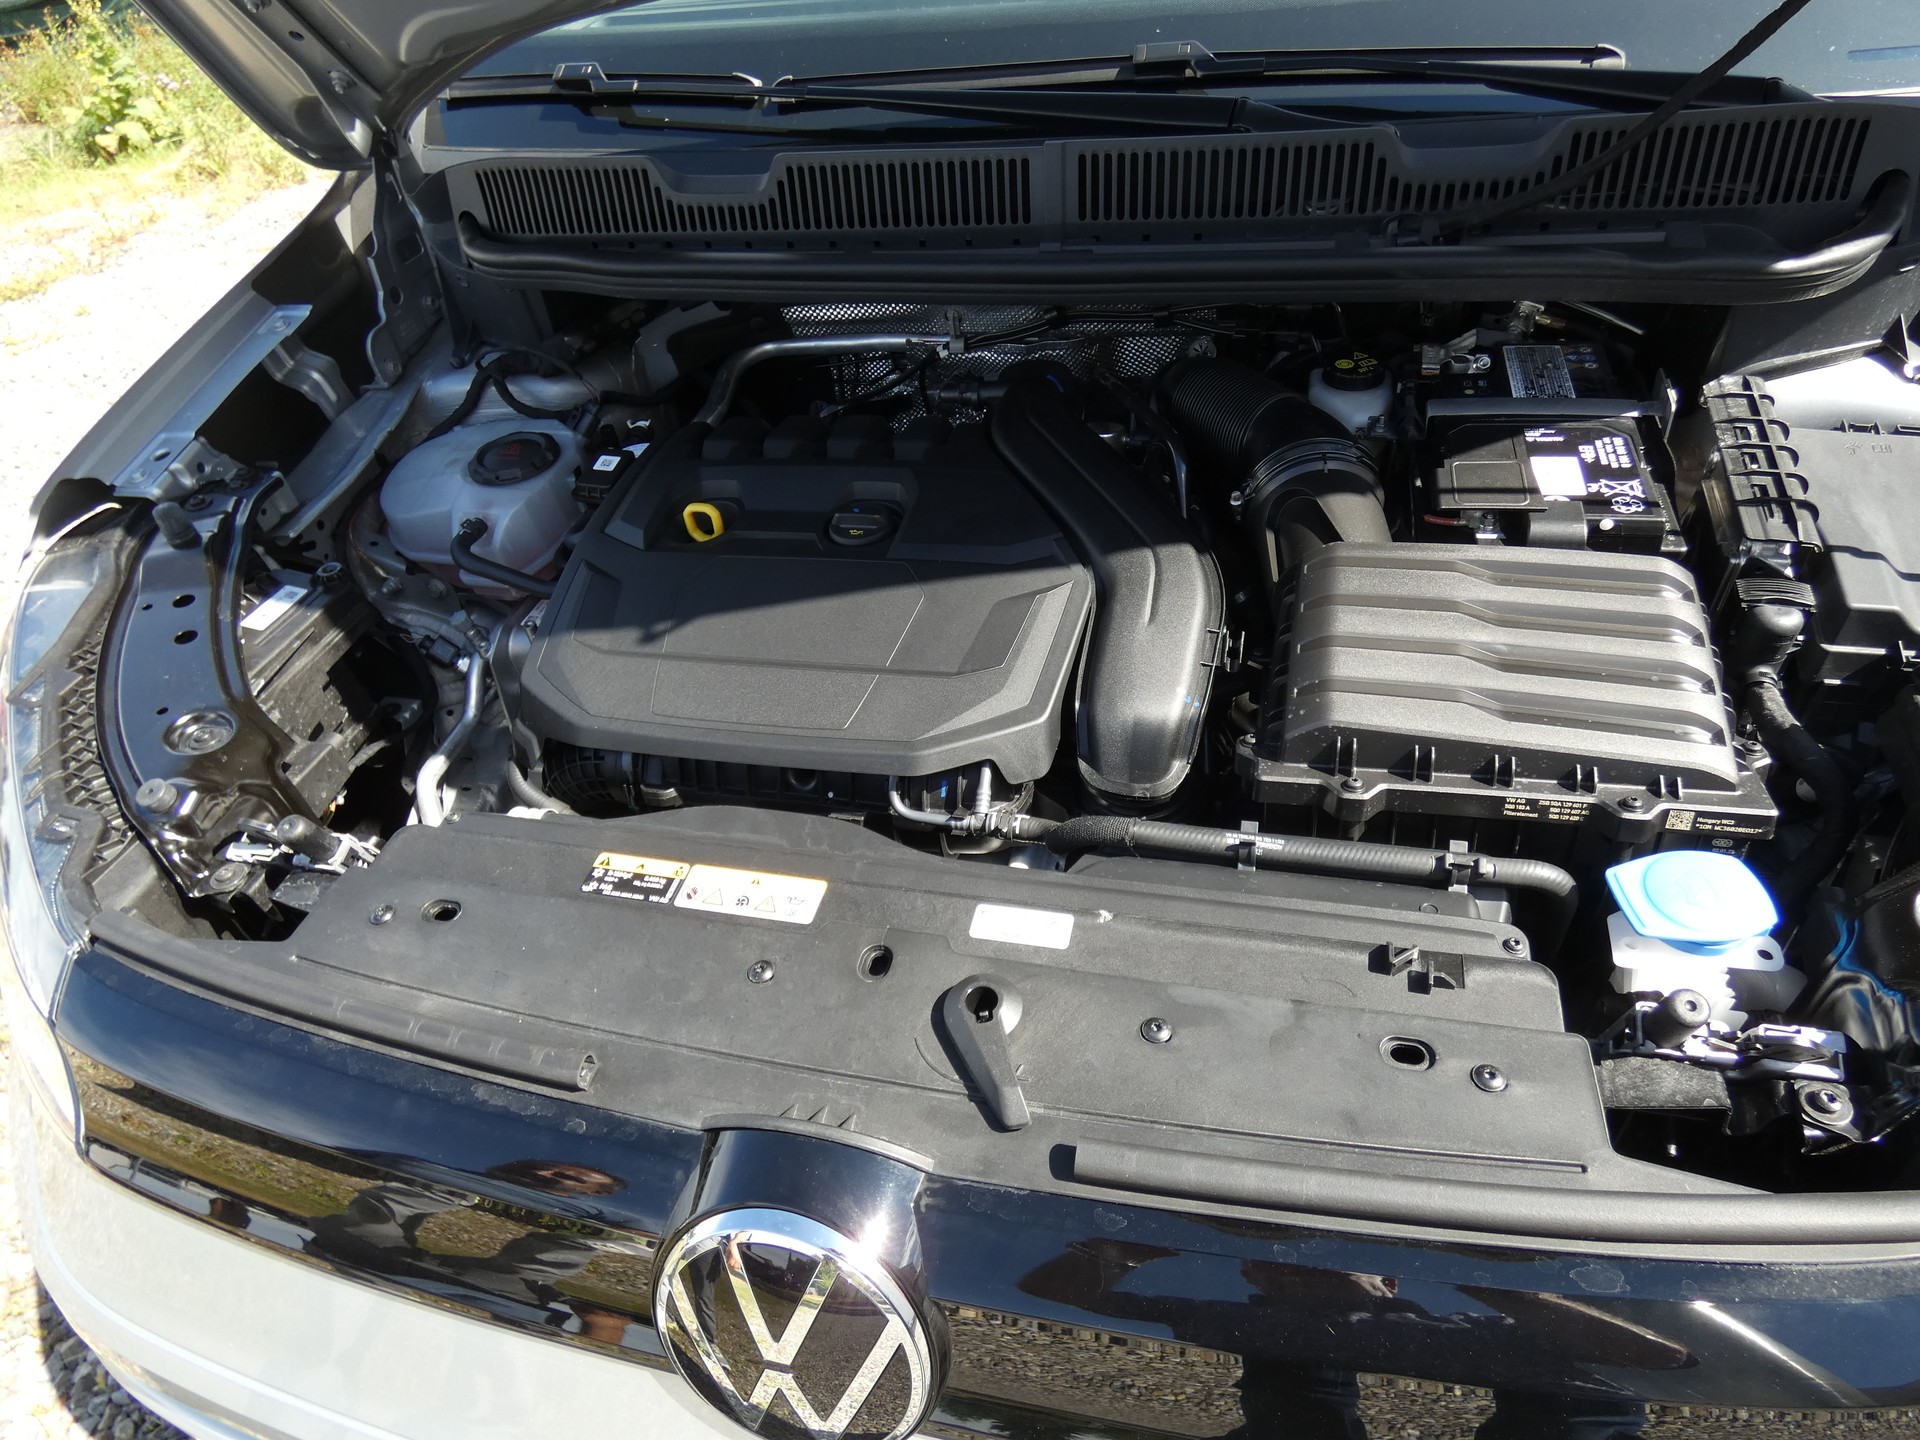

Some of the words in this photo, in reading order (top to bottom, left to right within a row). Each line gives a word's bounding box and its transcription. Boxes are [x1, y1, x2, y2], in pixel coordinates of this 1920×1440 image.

[1503, 810, 1539, 818] Filterelement
[1696, 817, 1721, 825] Hungary
[657, 1220, 928, 1440] VW
